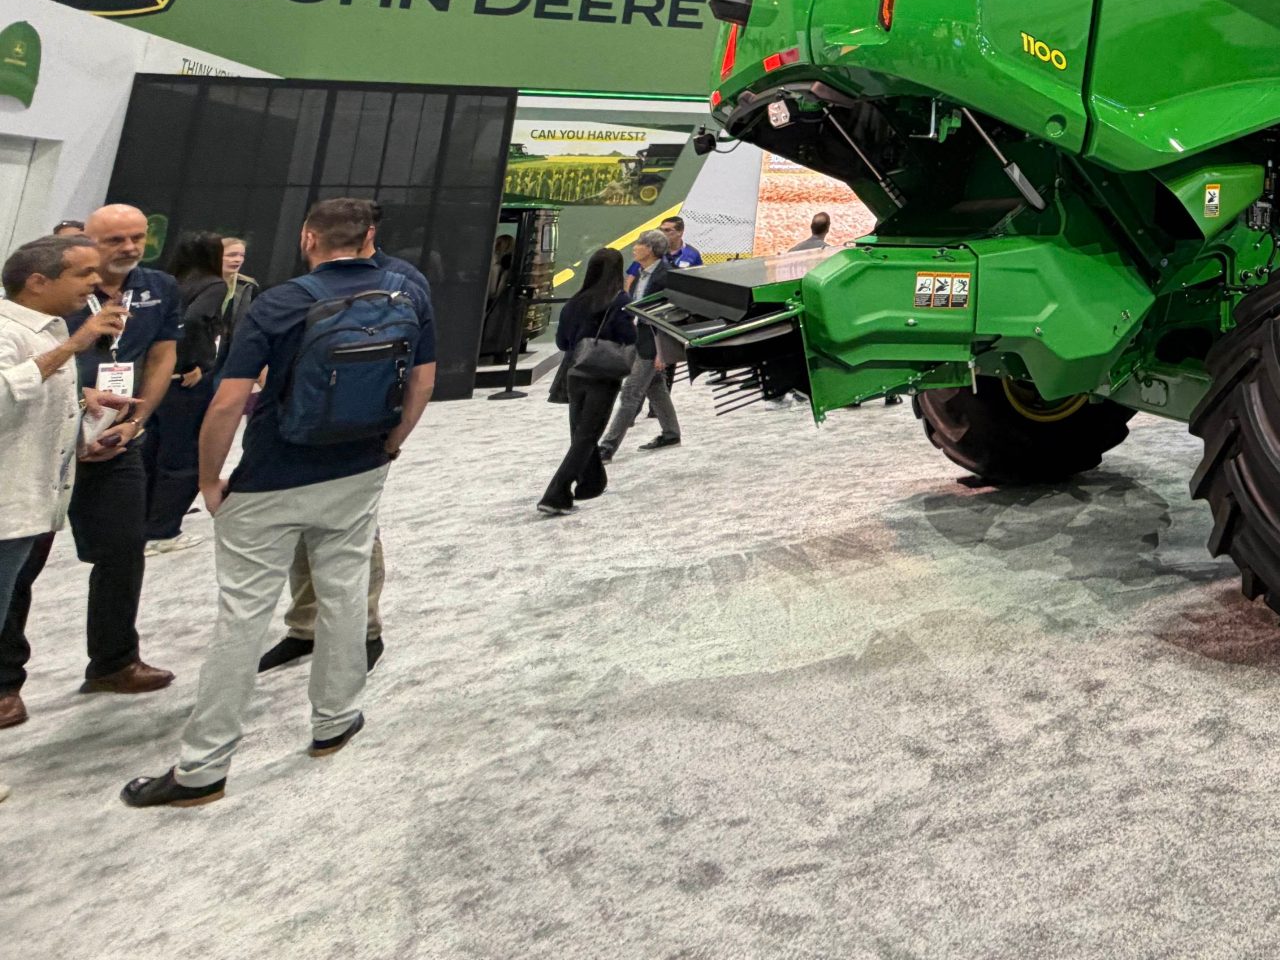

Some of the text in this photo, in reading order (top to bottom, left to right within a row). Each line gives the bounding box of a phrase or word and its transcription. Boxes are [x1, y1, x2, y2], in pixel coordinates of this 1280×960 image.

[1020, 31, 1068, 71] 1100
[530, 129, 647, 141] CAN YOU HARVEST?
